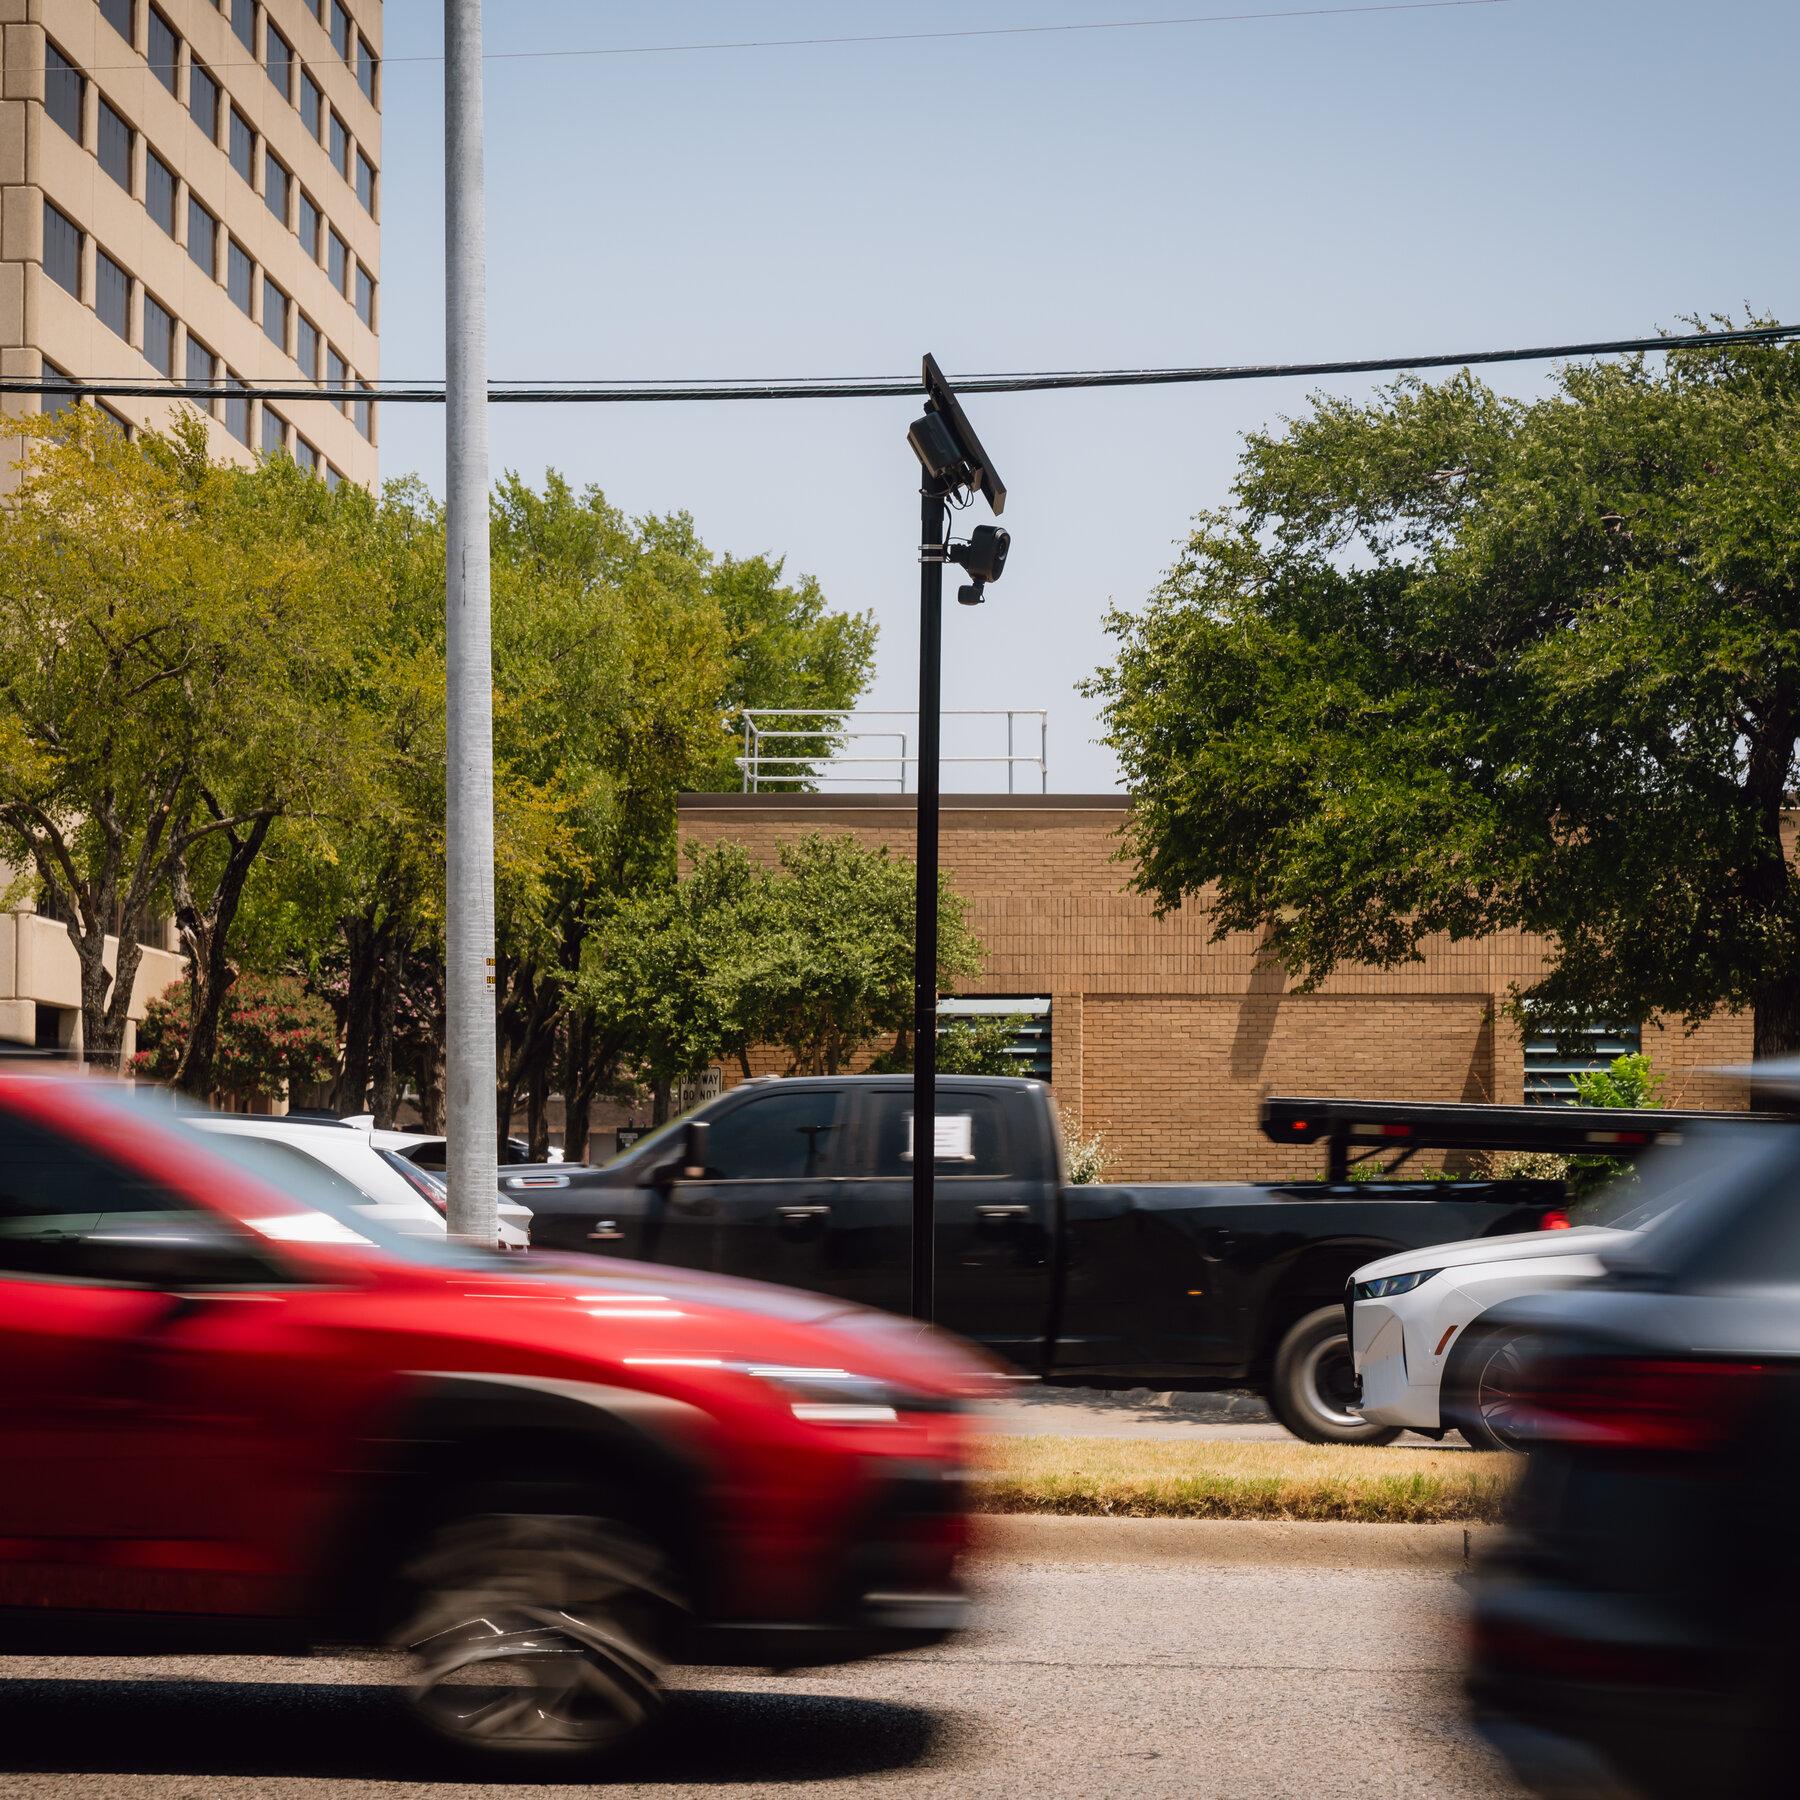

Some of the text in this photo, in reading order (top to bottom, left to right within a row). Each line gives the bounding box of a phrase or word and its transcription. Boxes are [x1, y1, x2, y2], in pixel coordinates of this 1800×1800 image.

[702, 1074, 718, 1085] WAY
[683, 1090, 717, 1101] DO NOT
